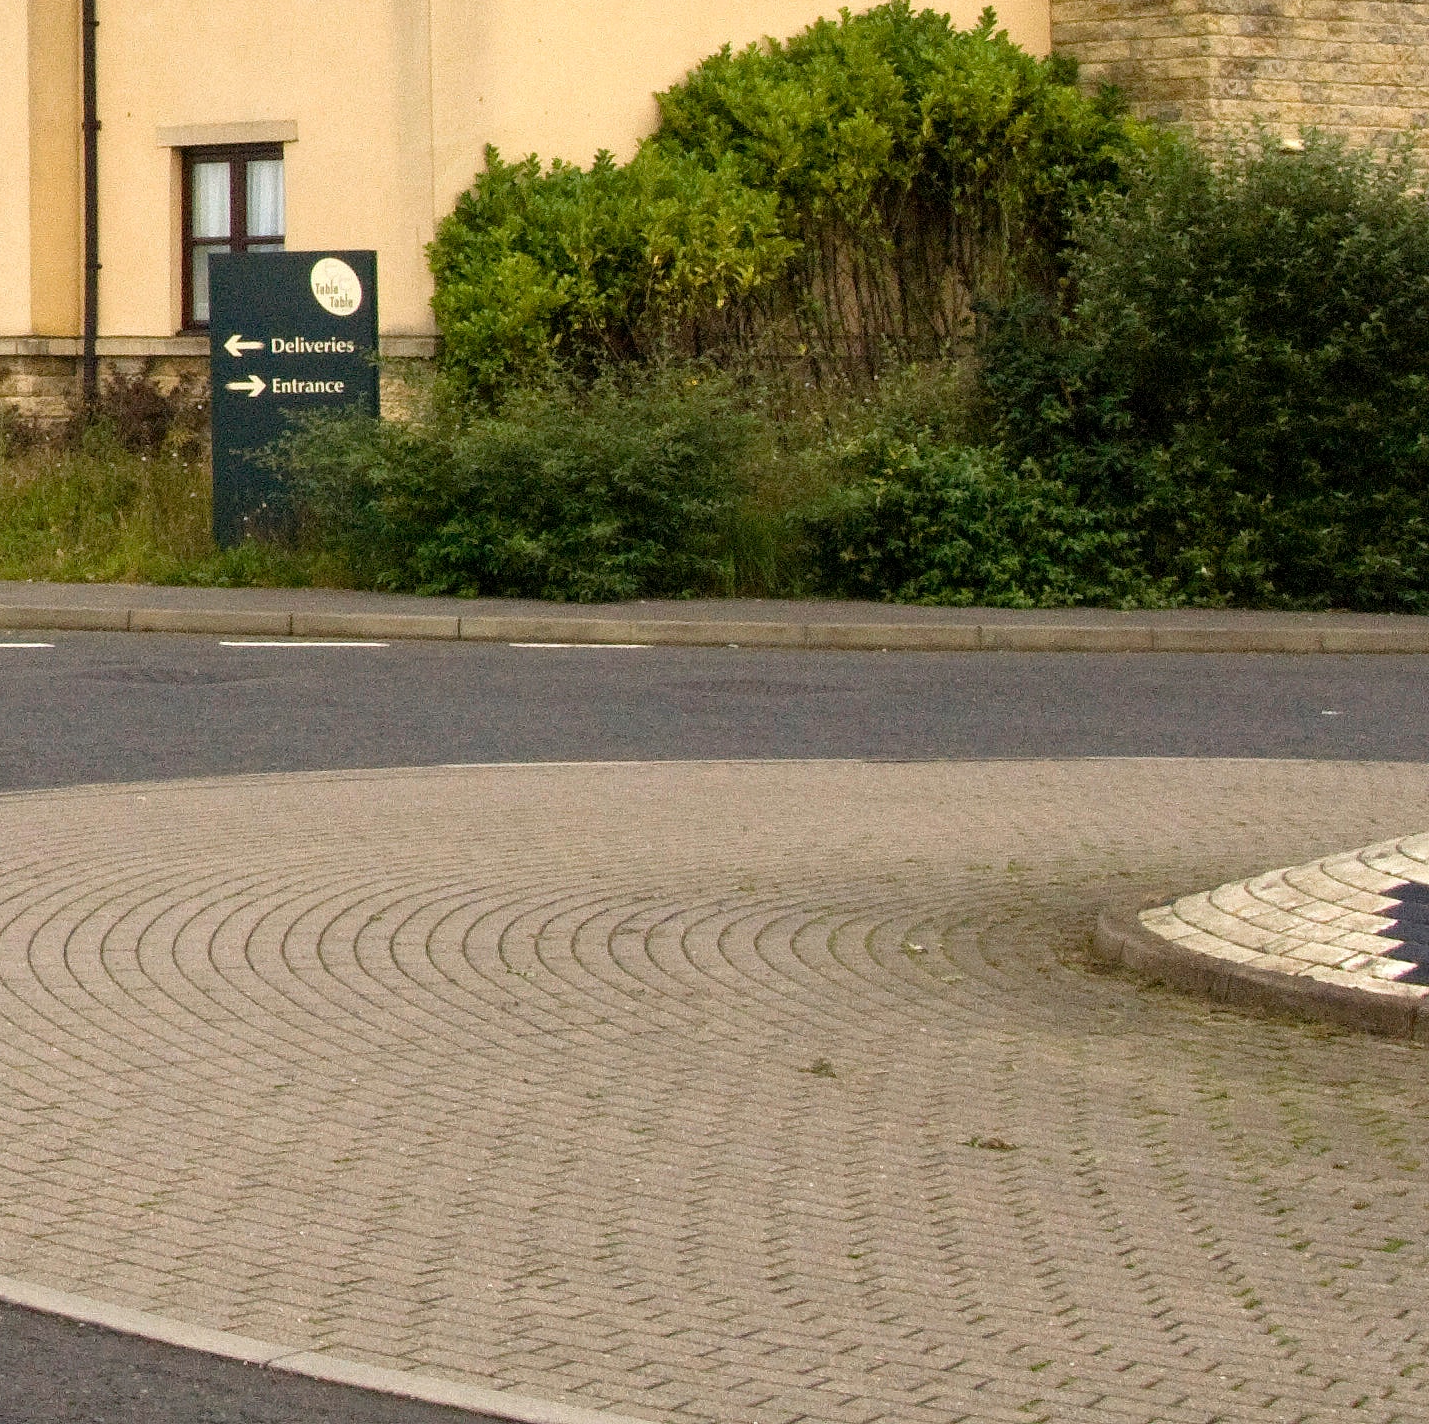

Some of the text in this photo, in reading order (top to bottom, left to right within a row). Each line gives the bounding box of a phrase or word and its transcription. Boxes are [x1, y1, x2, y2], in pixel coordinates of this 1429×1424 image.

[315, 280, 339, 296] Table
[330, 293, 353, 308] Table
[271, 336, 355, 354] Deliveries
[272, 377, 345, 394] Entrance
